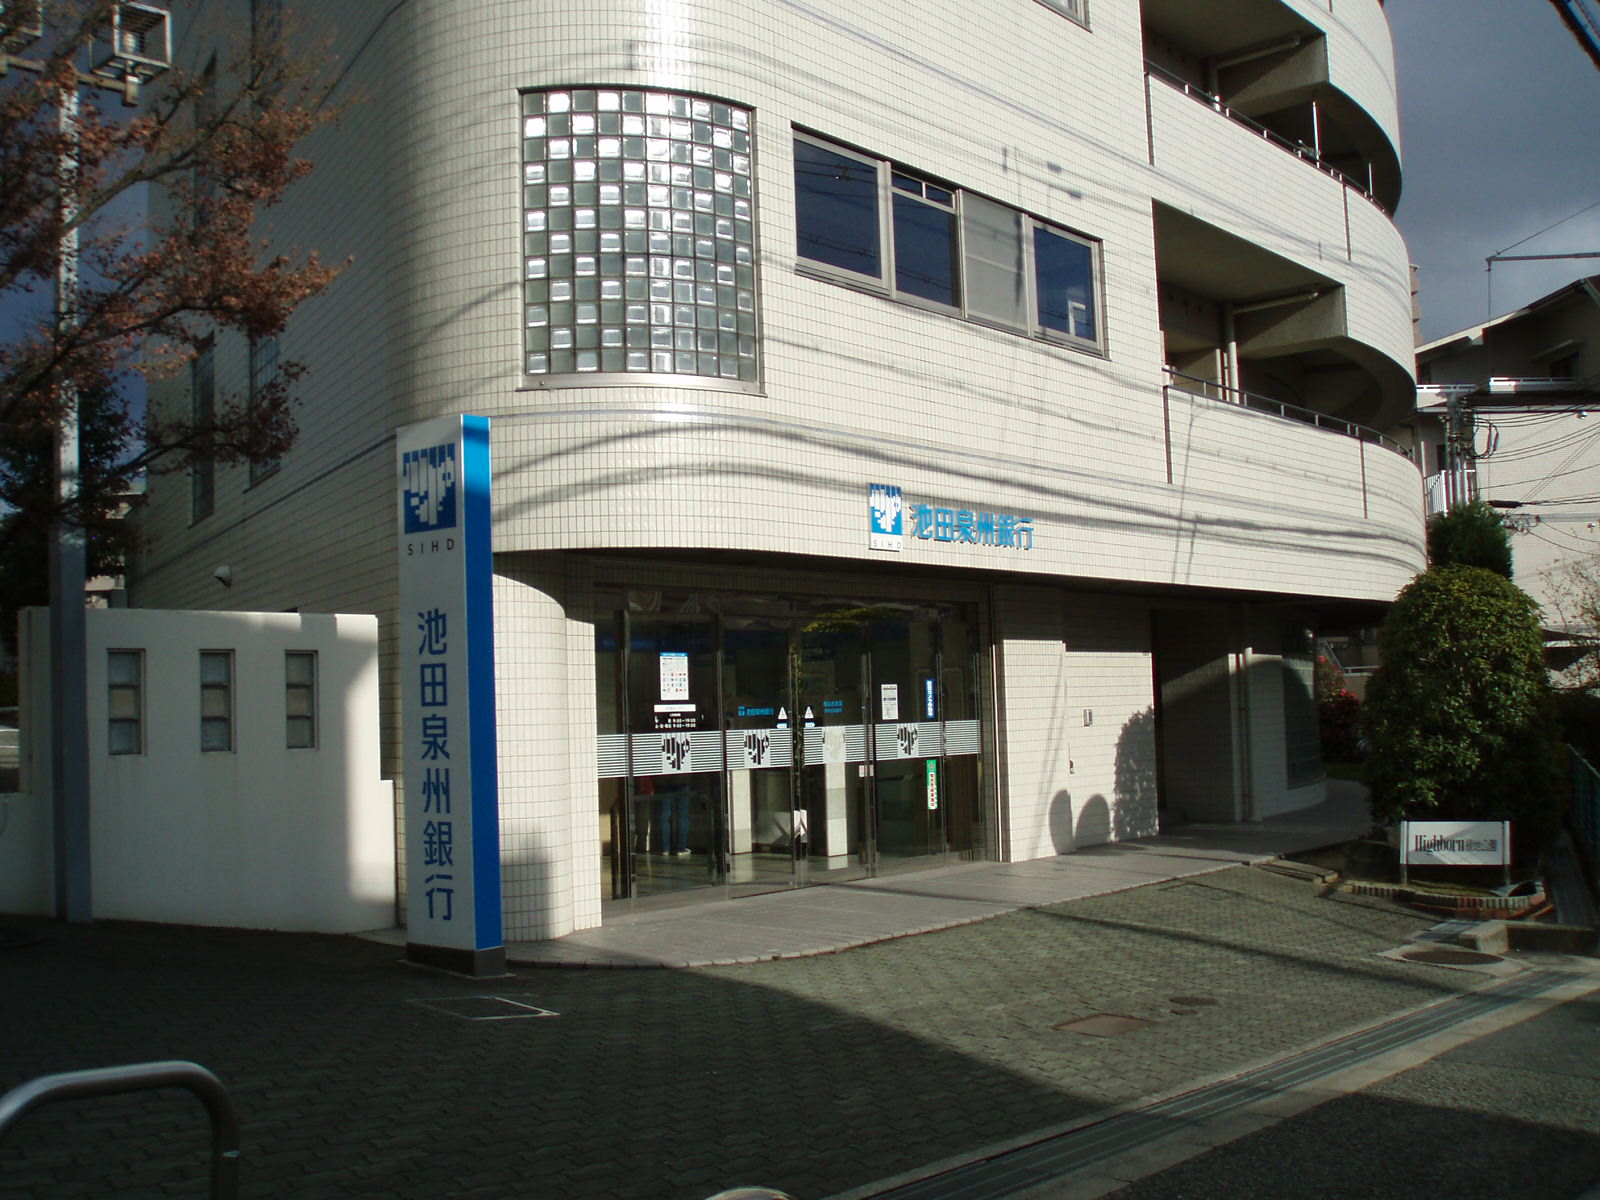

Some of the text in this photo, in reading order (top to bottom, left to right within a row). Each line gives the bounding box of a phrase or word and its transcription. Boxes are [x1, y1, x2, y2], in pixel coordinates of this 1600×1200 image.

[407, 538, 455, 556] SIHD
[909, 503, 1035, 550] 池田泉州銀行
[417, 608, 455, 922] 池田泉州銀行
